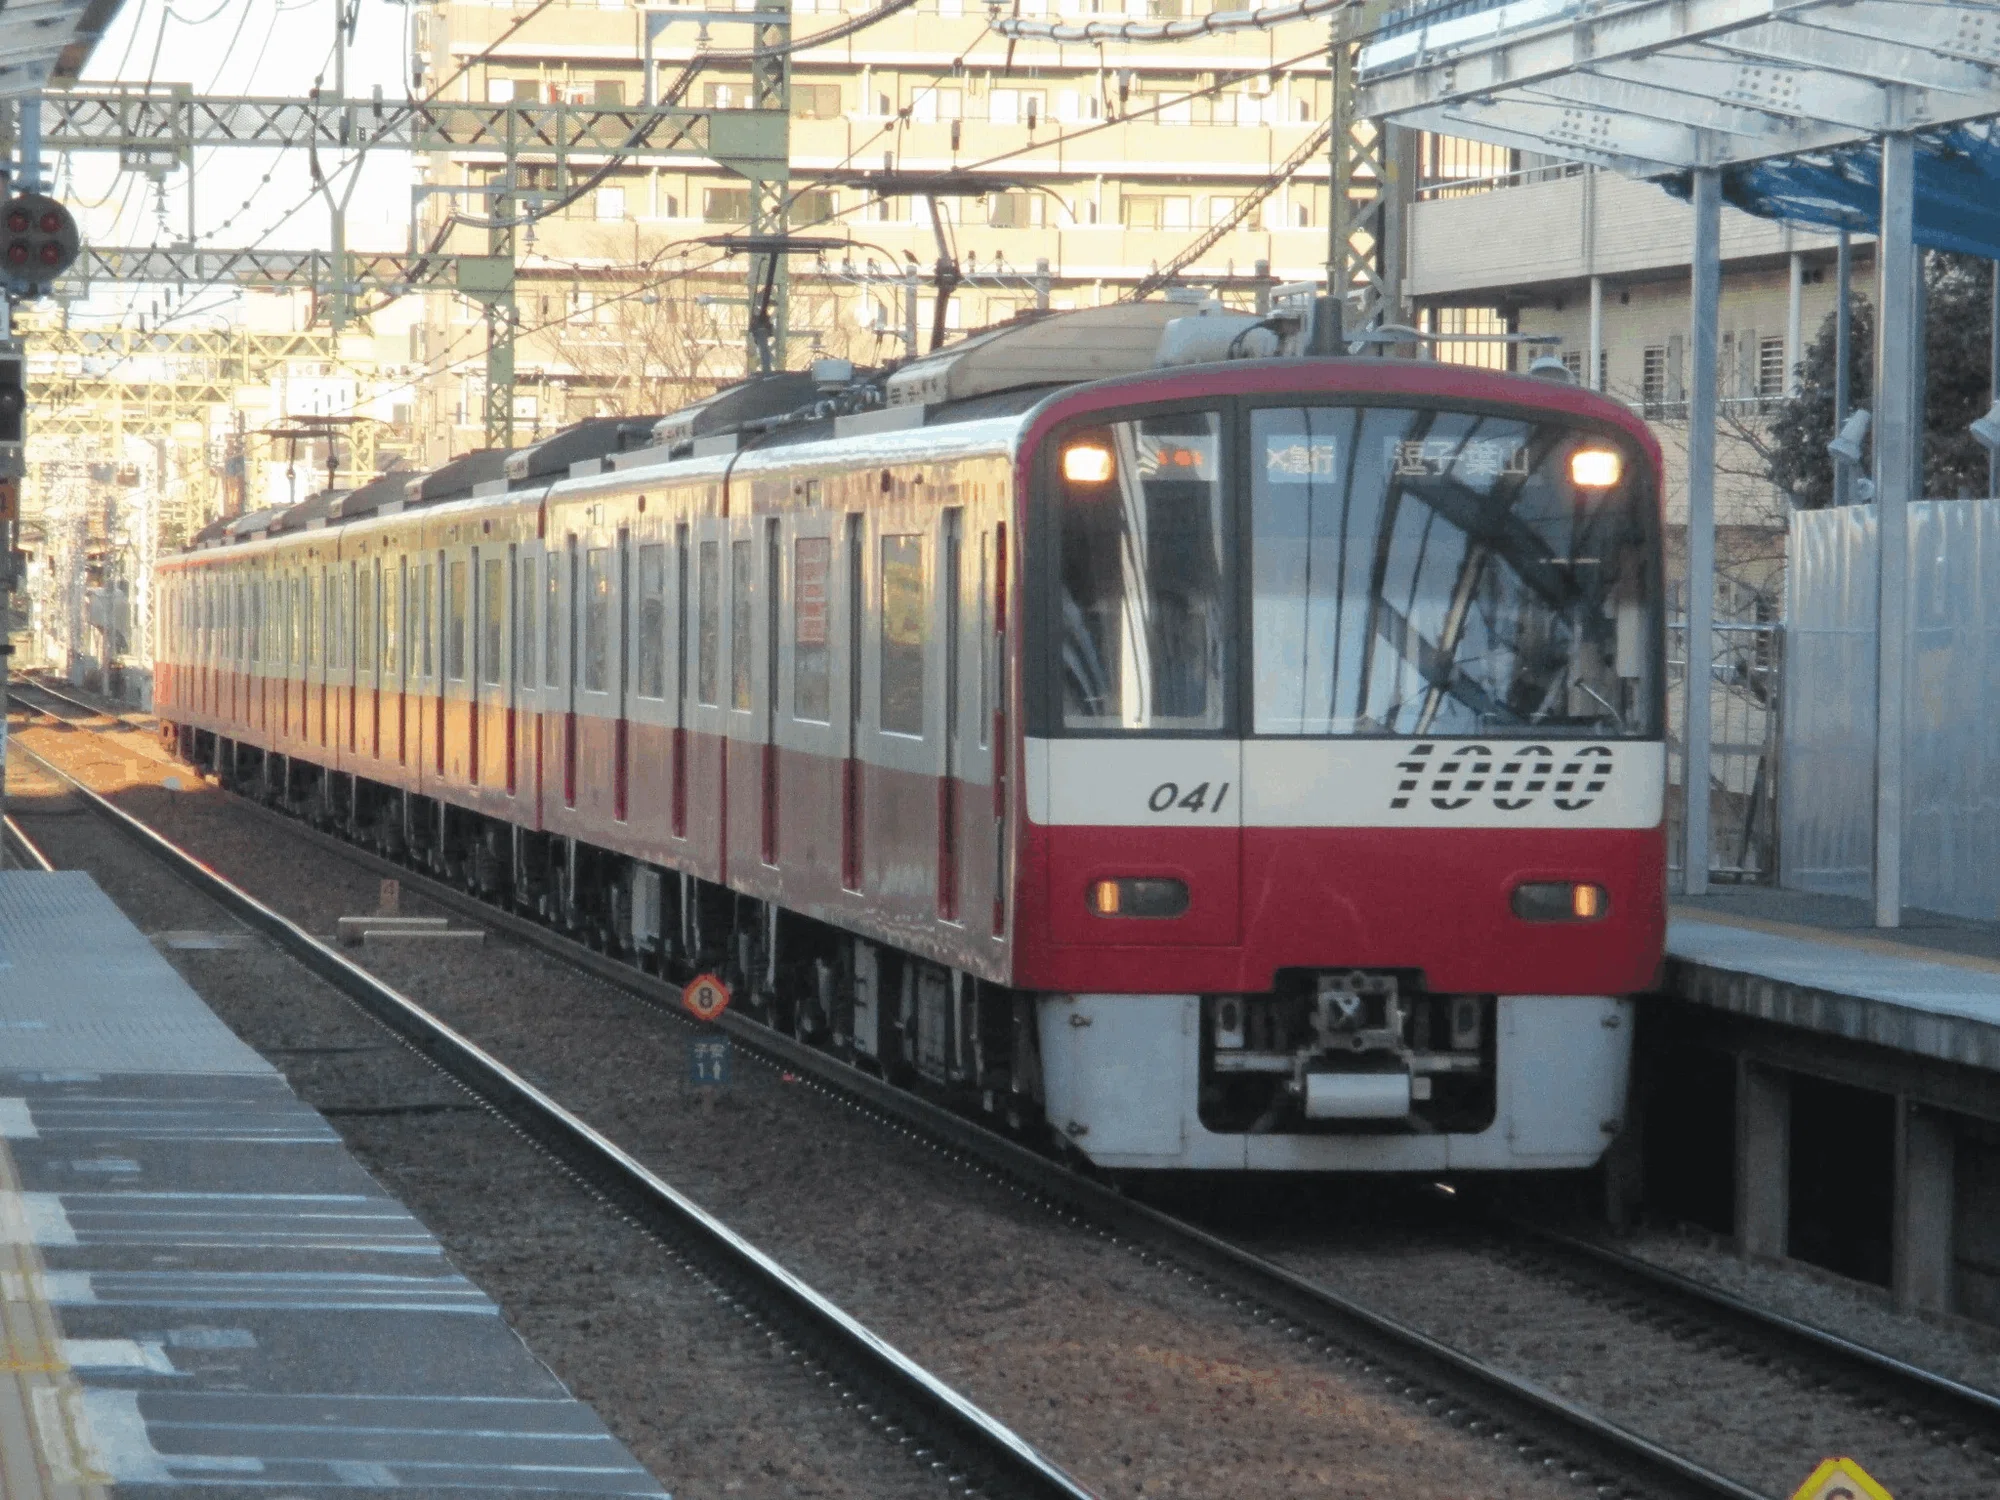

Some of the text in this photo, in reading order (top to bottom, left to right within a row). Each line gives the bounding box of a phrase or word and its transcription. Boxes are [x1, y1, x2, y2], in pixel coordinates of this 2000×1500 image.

[1389, 743, 1614, 811] 1000
[1148, 782, 1230, 813] 041
[699, 987, 713, 1008] 8
